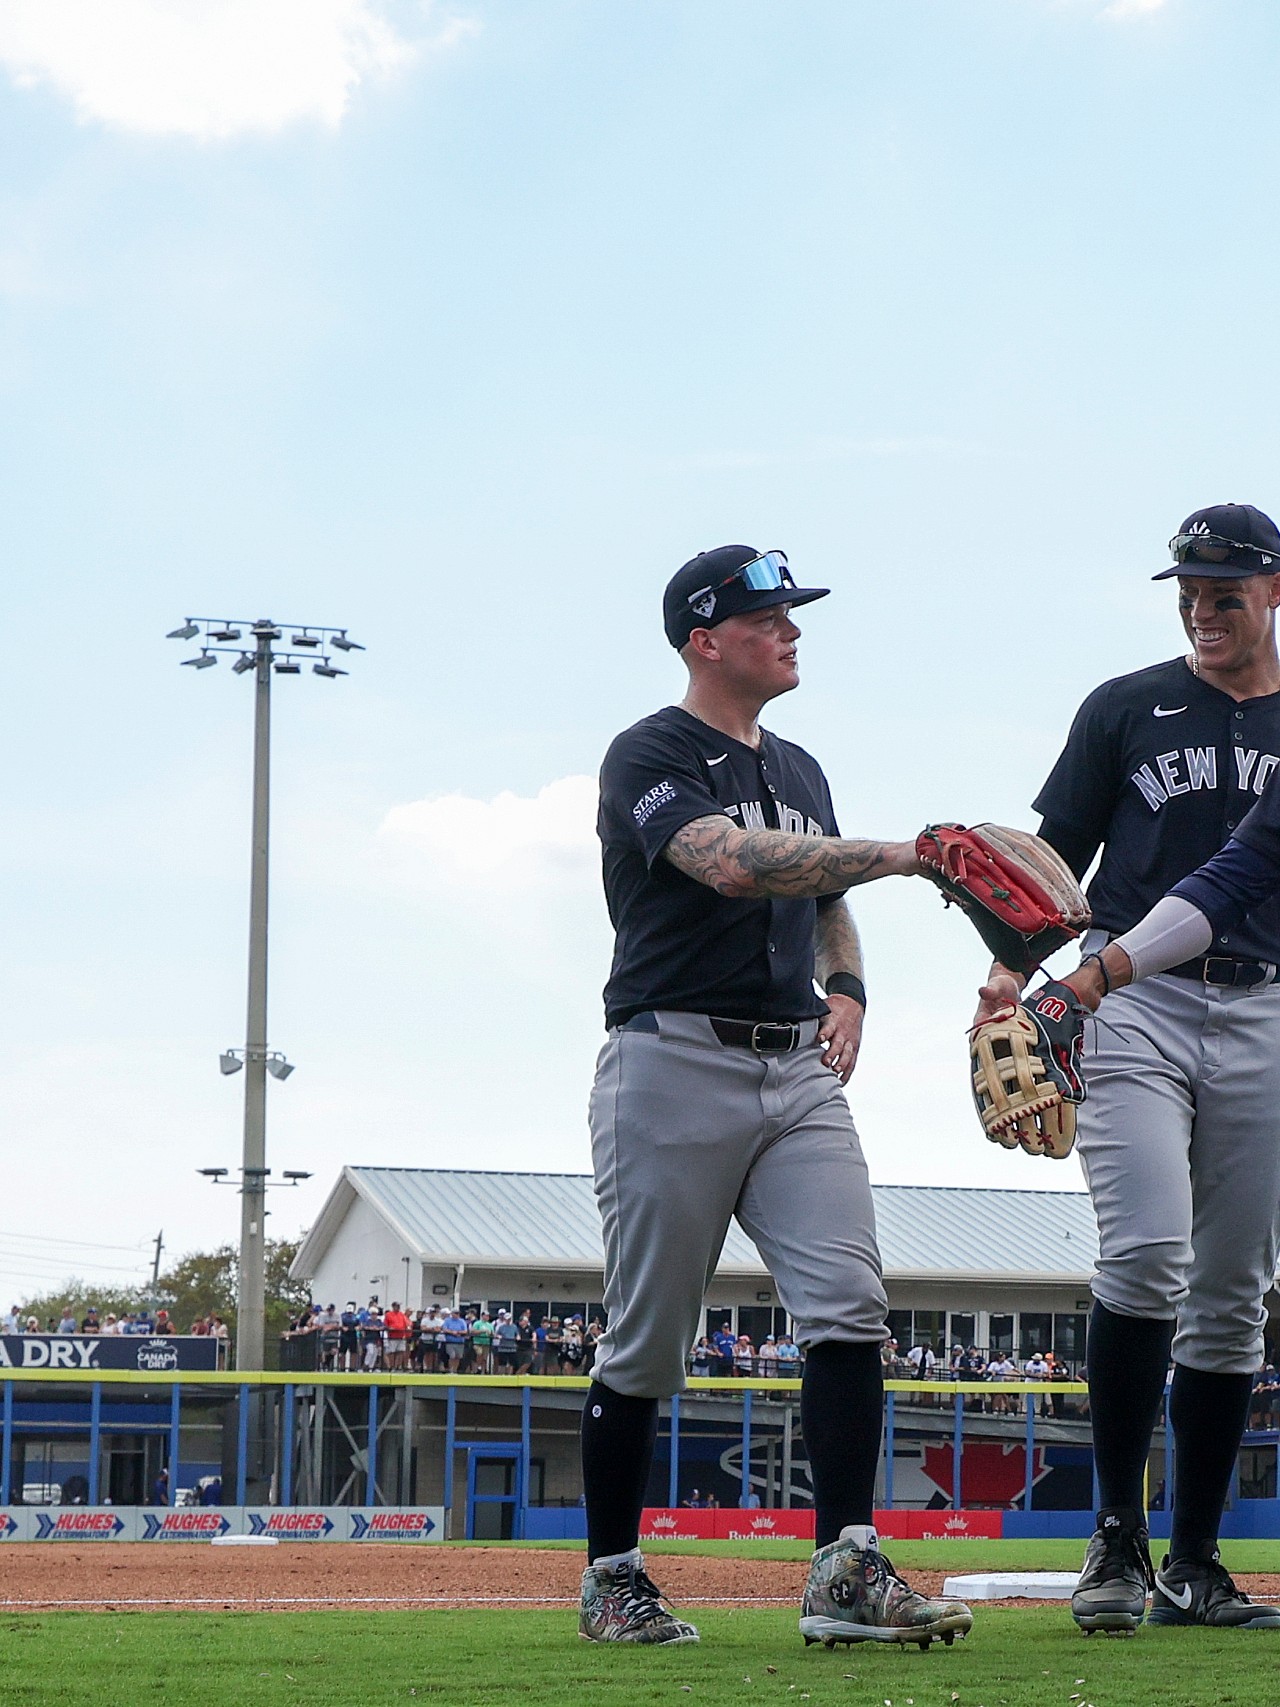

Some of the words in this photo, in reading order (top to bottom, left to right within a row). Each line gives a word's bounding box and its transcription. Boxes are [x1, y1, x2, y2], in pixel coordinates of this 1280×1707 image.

[1131, 746, 1217, 812] NEW
[1234, 746, 1280, 796] YO
[632, 781, 673, 820] STARR
[774, 800, 824, 837] YOR
[21, 1340, 99, 1367] DRY
[137, 1352, 177, 1362] CANADA
[147, 1360, 167, 1369] DRY
[56, 1513, 116, 1530] HUGHES
[161, 1513, 221, 1530] HUGHES
[266, 1513, 325, 1530] HUGHES
[369, 1513, 426, 1530] HUGHES
[52, 1530, 110, 1539] EXTERMINATORS
[159, 1530, 217, 1539] EXTERMINATORS
[265, 1530, 320, 1539] EXTERMINATORS
[367, 1530, 422, 1539] EXTERMINATORS
[639, 1531, 698, 1540] udweiser
